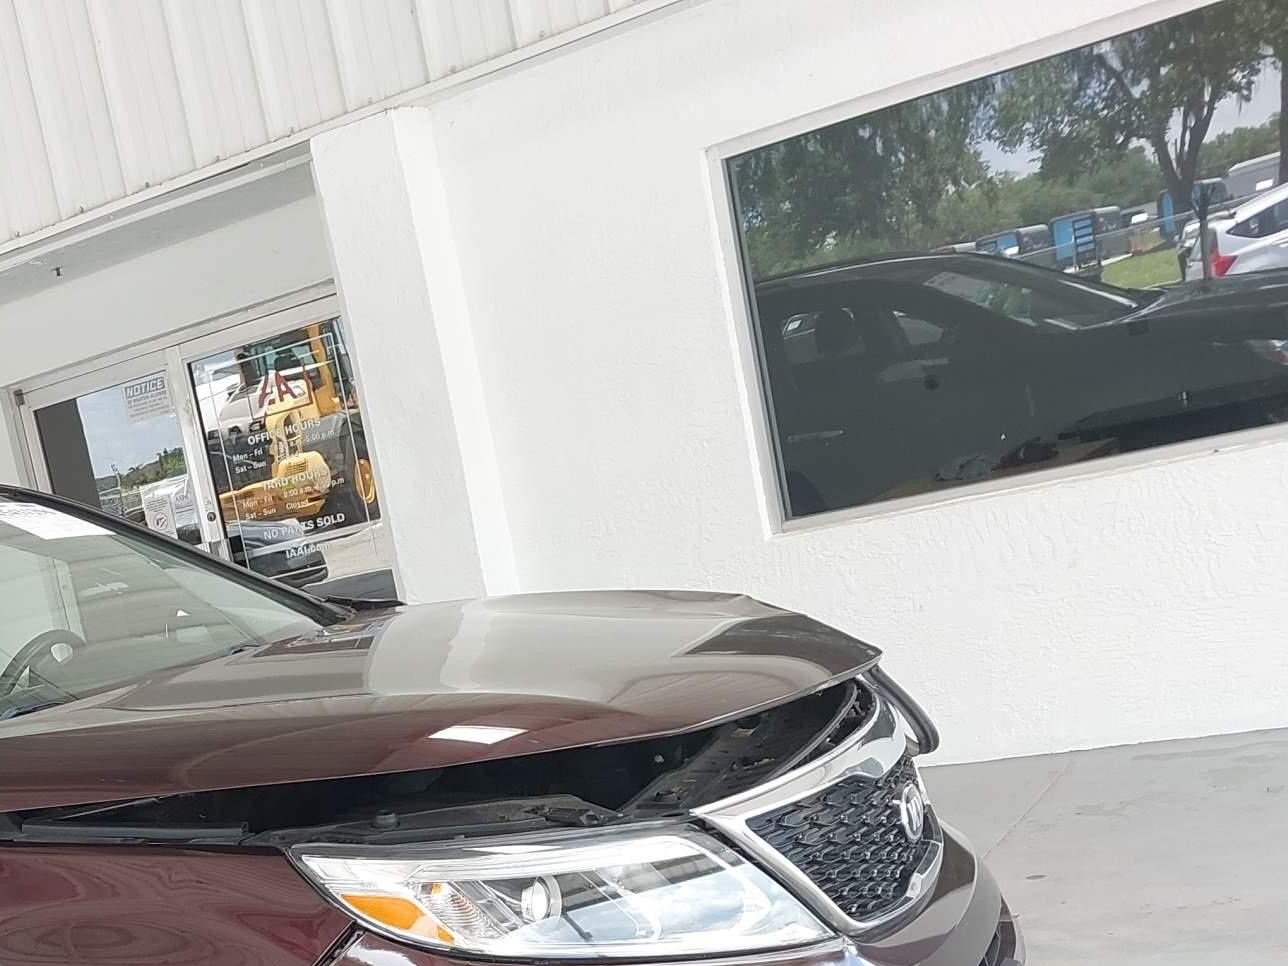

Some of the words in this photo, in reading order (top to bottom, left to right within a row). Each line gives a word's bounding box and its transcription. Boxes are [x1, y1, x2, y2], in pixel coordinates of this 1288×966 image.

[126, 378, 163, 397] NOTICE
[247, 428, 282, 446] OFFICE
[285, 418, 321, 436] HOURS
[232, 451, 248, 462] Mon
[235, 464, 247, 474] Sat
[252, 460, 267, 469] Sun
[244, 511, 257, 520] Sat
[263, 507, 277, 516] Sun
[263, 529, 278, 540] NO
[316, 512, 345, 527] SOLD
